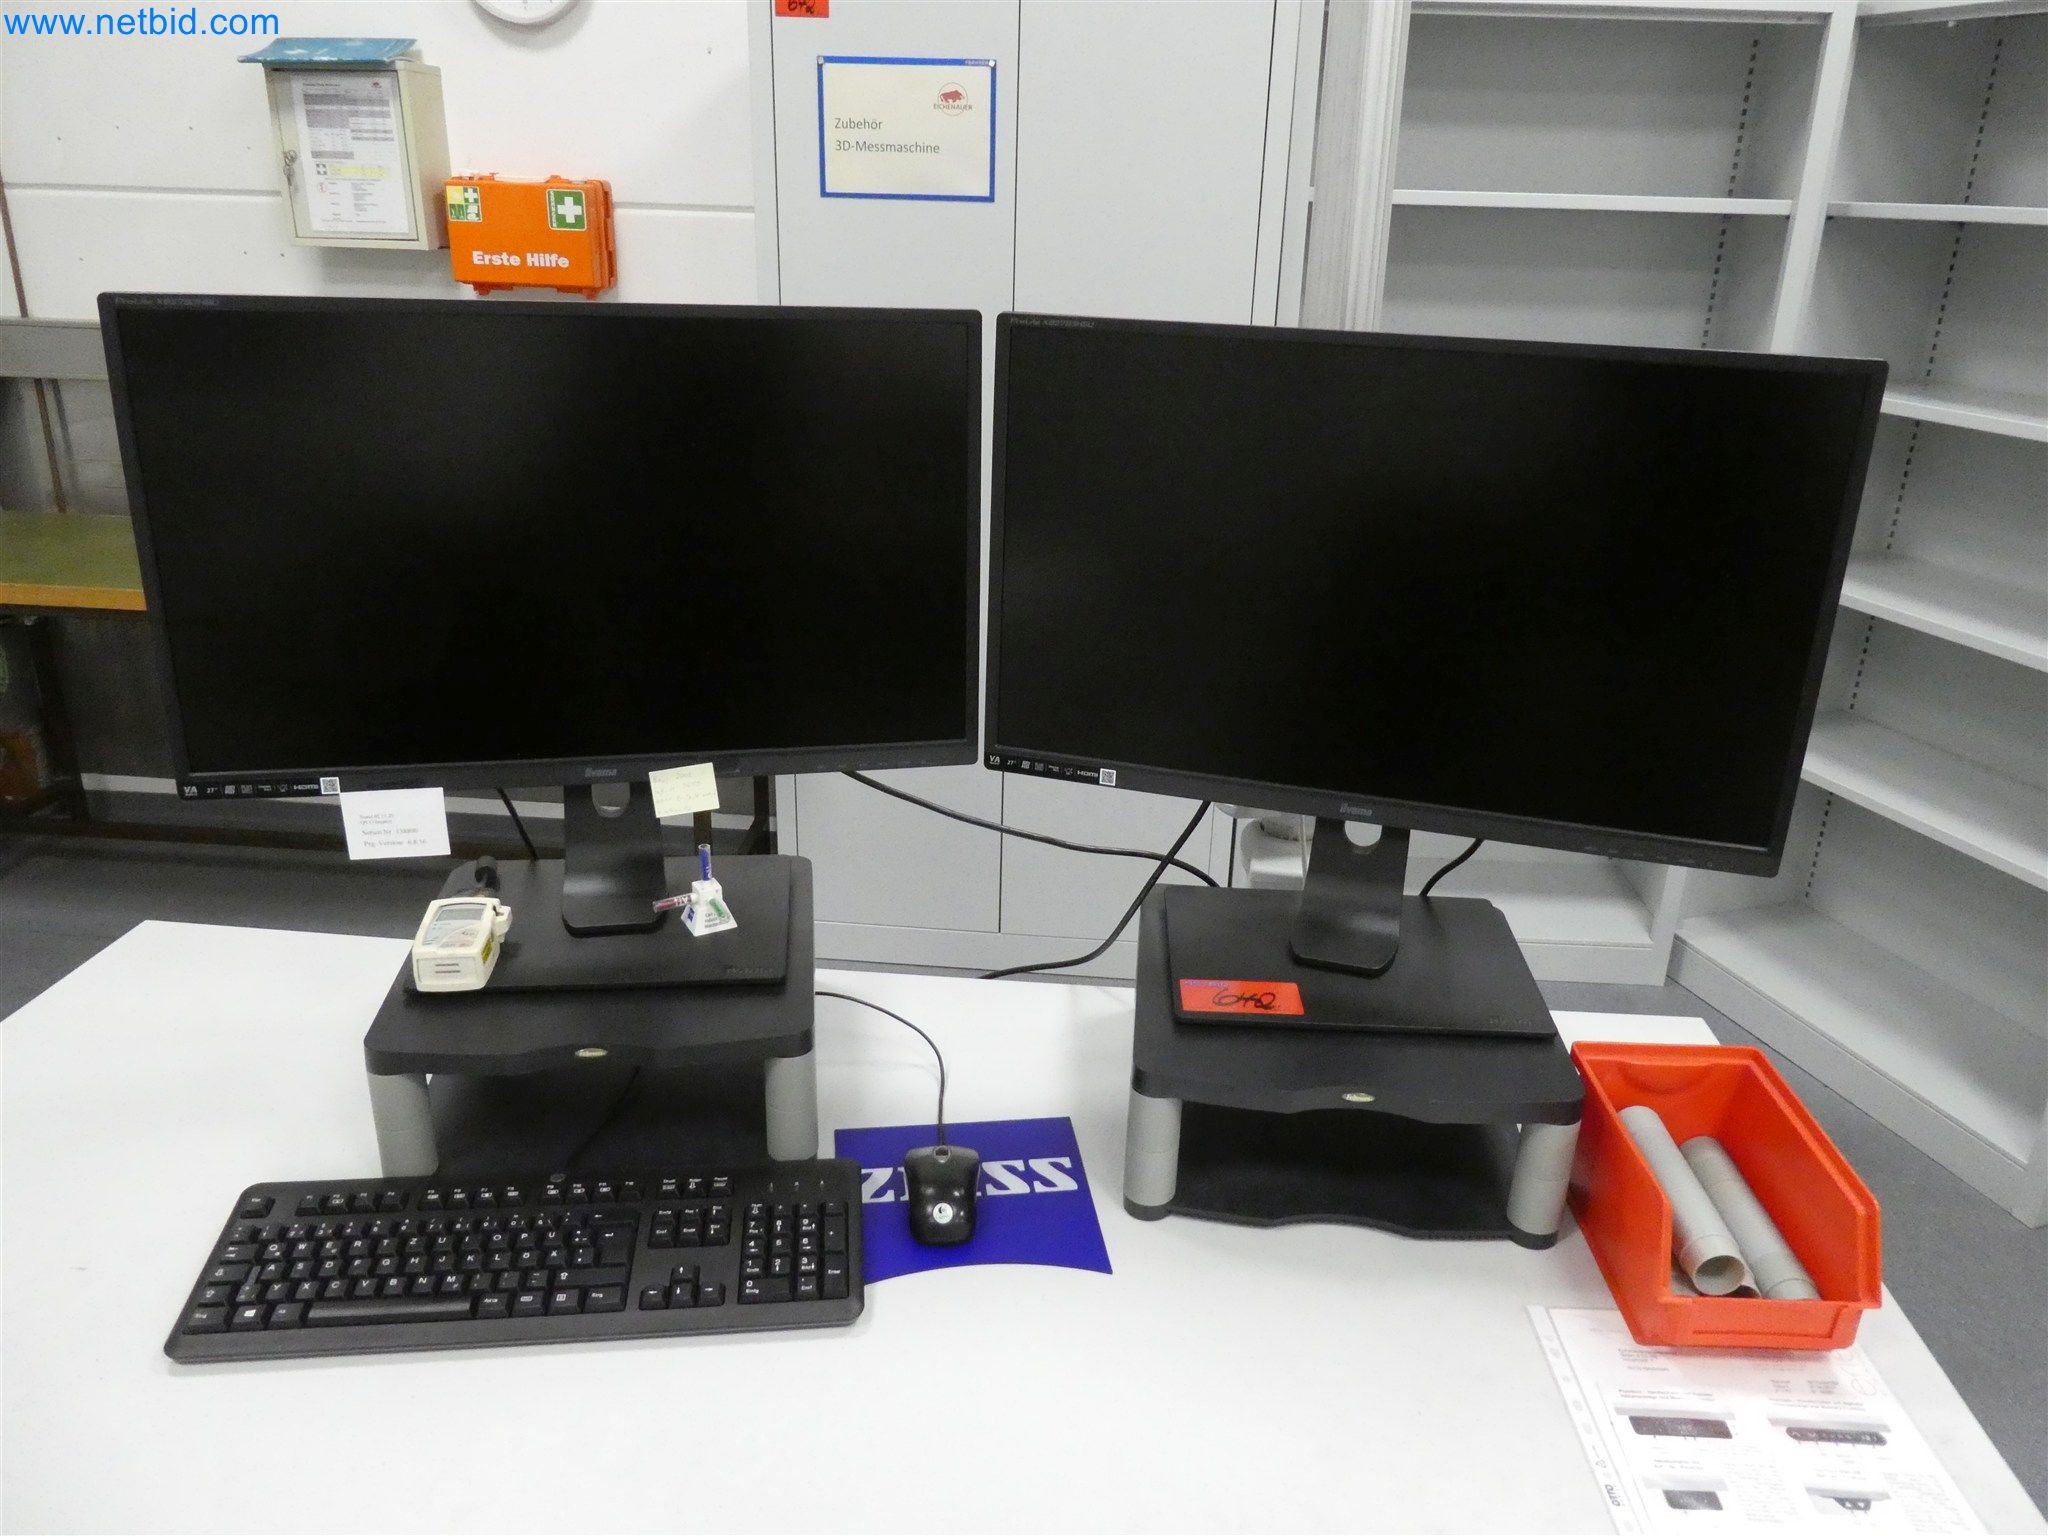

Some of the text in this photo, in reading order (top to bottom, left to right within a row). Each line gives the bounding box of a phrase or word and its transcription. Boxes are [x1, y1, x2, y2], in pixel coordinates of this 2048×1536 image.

[834, 117, 883, 130] Zubehör
[834, 140, 941, 154] 3D-Messmaschine
[472, 250, 570, 268] Erste Hilfe
[861, 1156, 1078, 1204] ZSS
